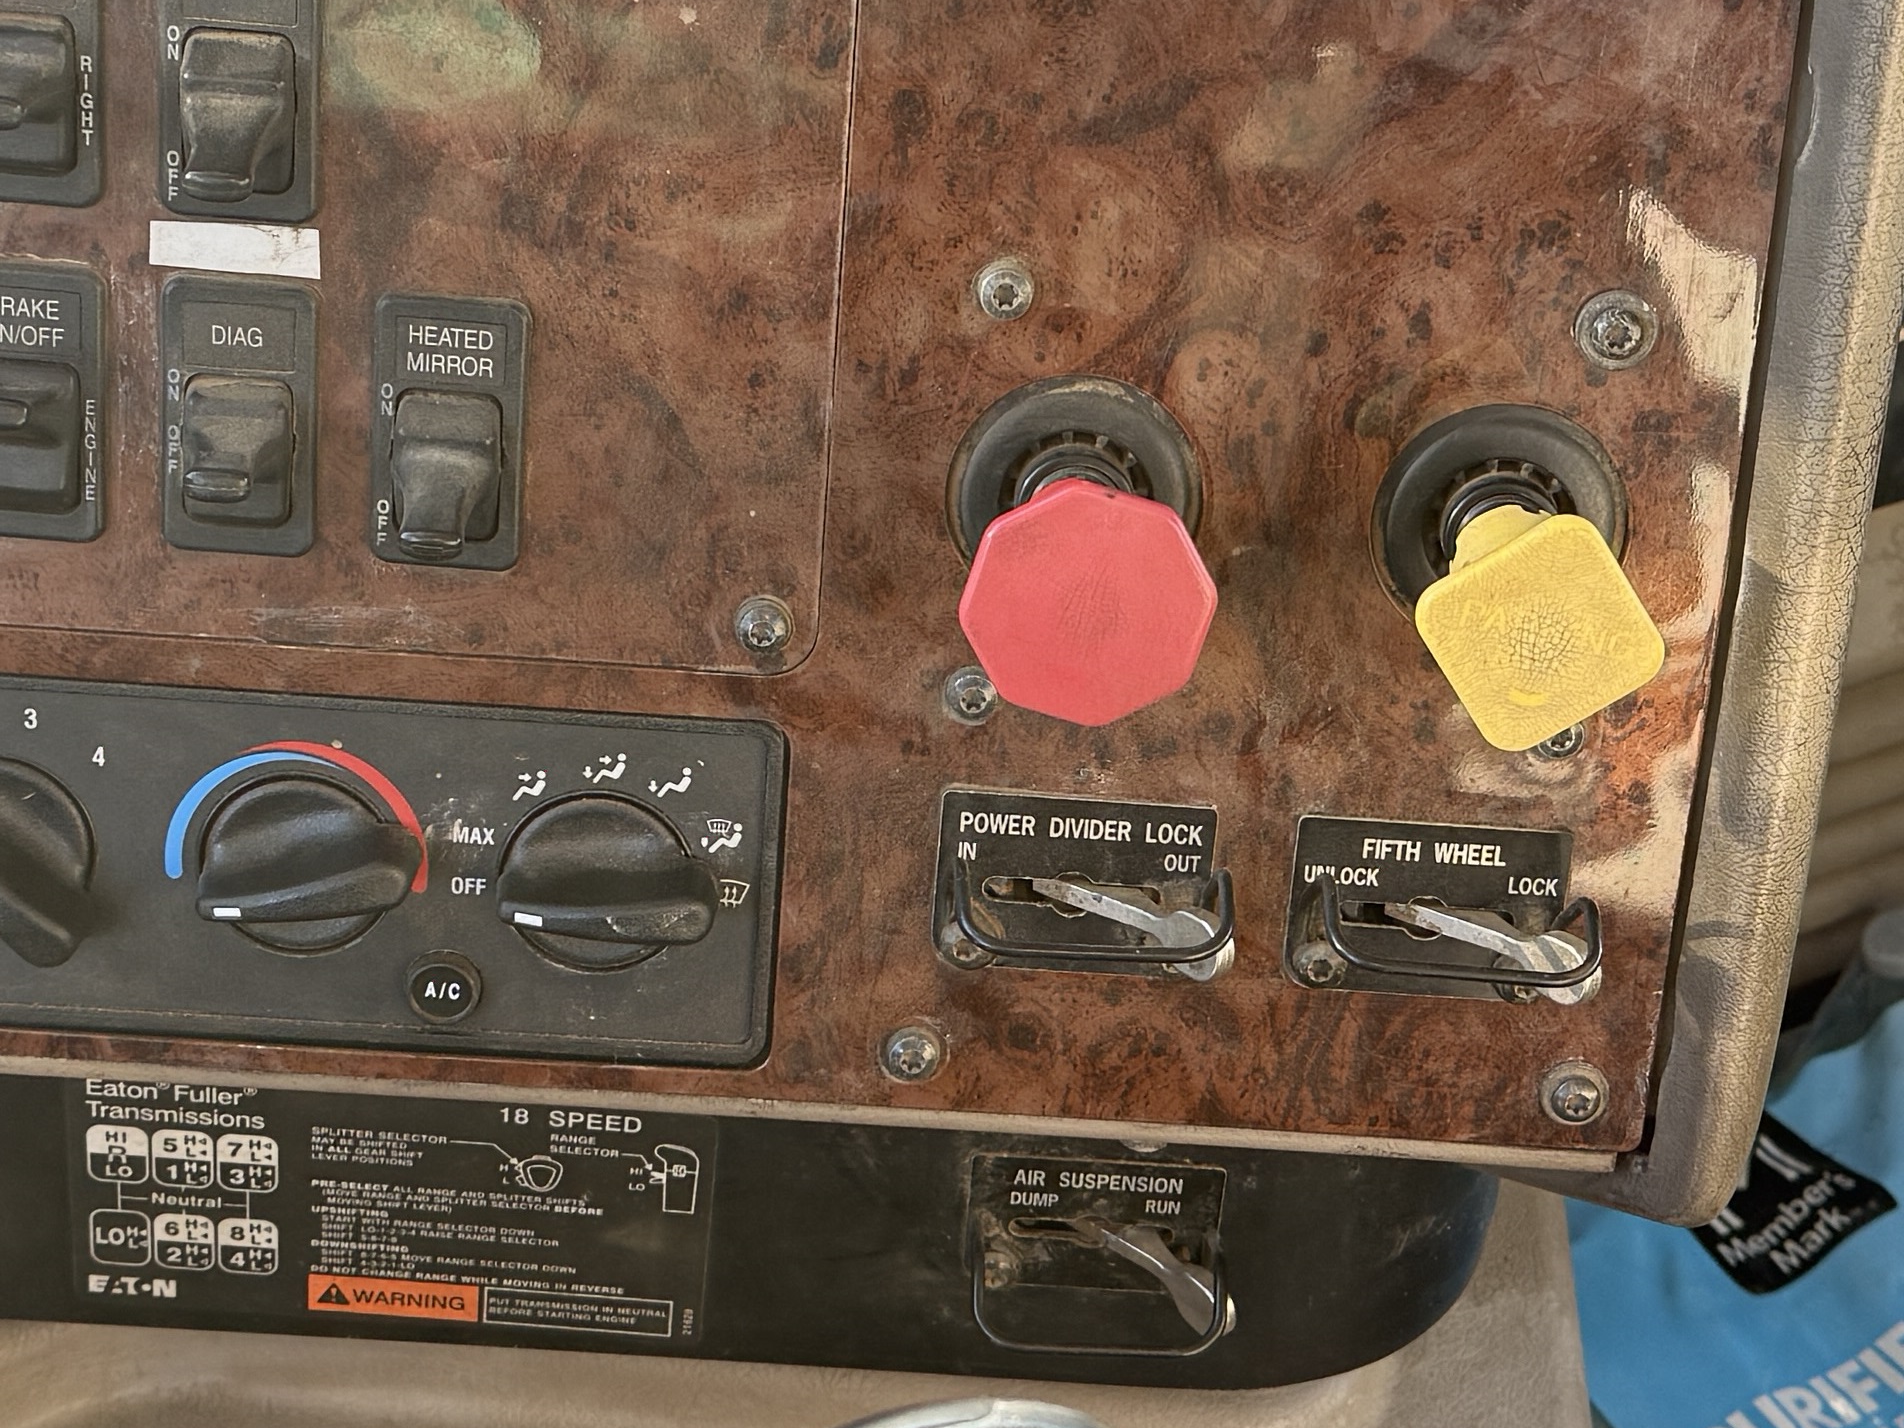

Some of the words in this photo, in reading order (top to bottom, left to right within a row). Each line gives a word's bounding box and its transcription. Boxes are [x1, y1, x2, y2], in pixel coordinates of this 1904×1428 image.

[79, 55, 93, 146] RIGHT
[211, 323, 264, 349] DIAG
[408, 323, 495, 351] HEATED
[406, 350, 493, 379] MIRROR
[84, 399, 96, 503] ENGINE
[23, 708, 38, 730] 3
[92, 746, 106, 767] 4
[452, 827, 495, 845] MAX
[959, 811, 1035, 838] POWER
[1048, 815, 1132, 843] DIVIDER
[1144, 821, 1204, 847] LOCK
[958, 841, 976, 861] IN
[1362, 838, 1422, 863] FIFTH
[1433, 841, 1506, 867] WHEEL
[1163, 854, 1202, 874] OUT
[451, 877, 487, 895] OFF
[1507, 876, 1557, 897] LOCK
[424, 981, 461, 1000] A/C
[85, 1100, 265, 1129] Transmissions
[500, 1107, 529, 1124] 18
[549, 1110, 643, 1134] SPEED
[550, 1133, 596, 1146] RANGE
[550, 1145, 619, 1158] SELECTOR
[1013, 1169, 1046, 1186] AIR
[1059, 1172, 1184, 1194] SUSPENSION
[151, 1192, 221, 1209] Neutral
[1010, 1191, 1059, 1207] DUMP
[1145, 1200, 1181, 1215] RUN
[1716, 1170, 1856, 1267] Member's
[353, 1288, 465, 1311] WARNING
